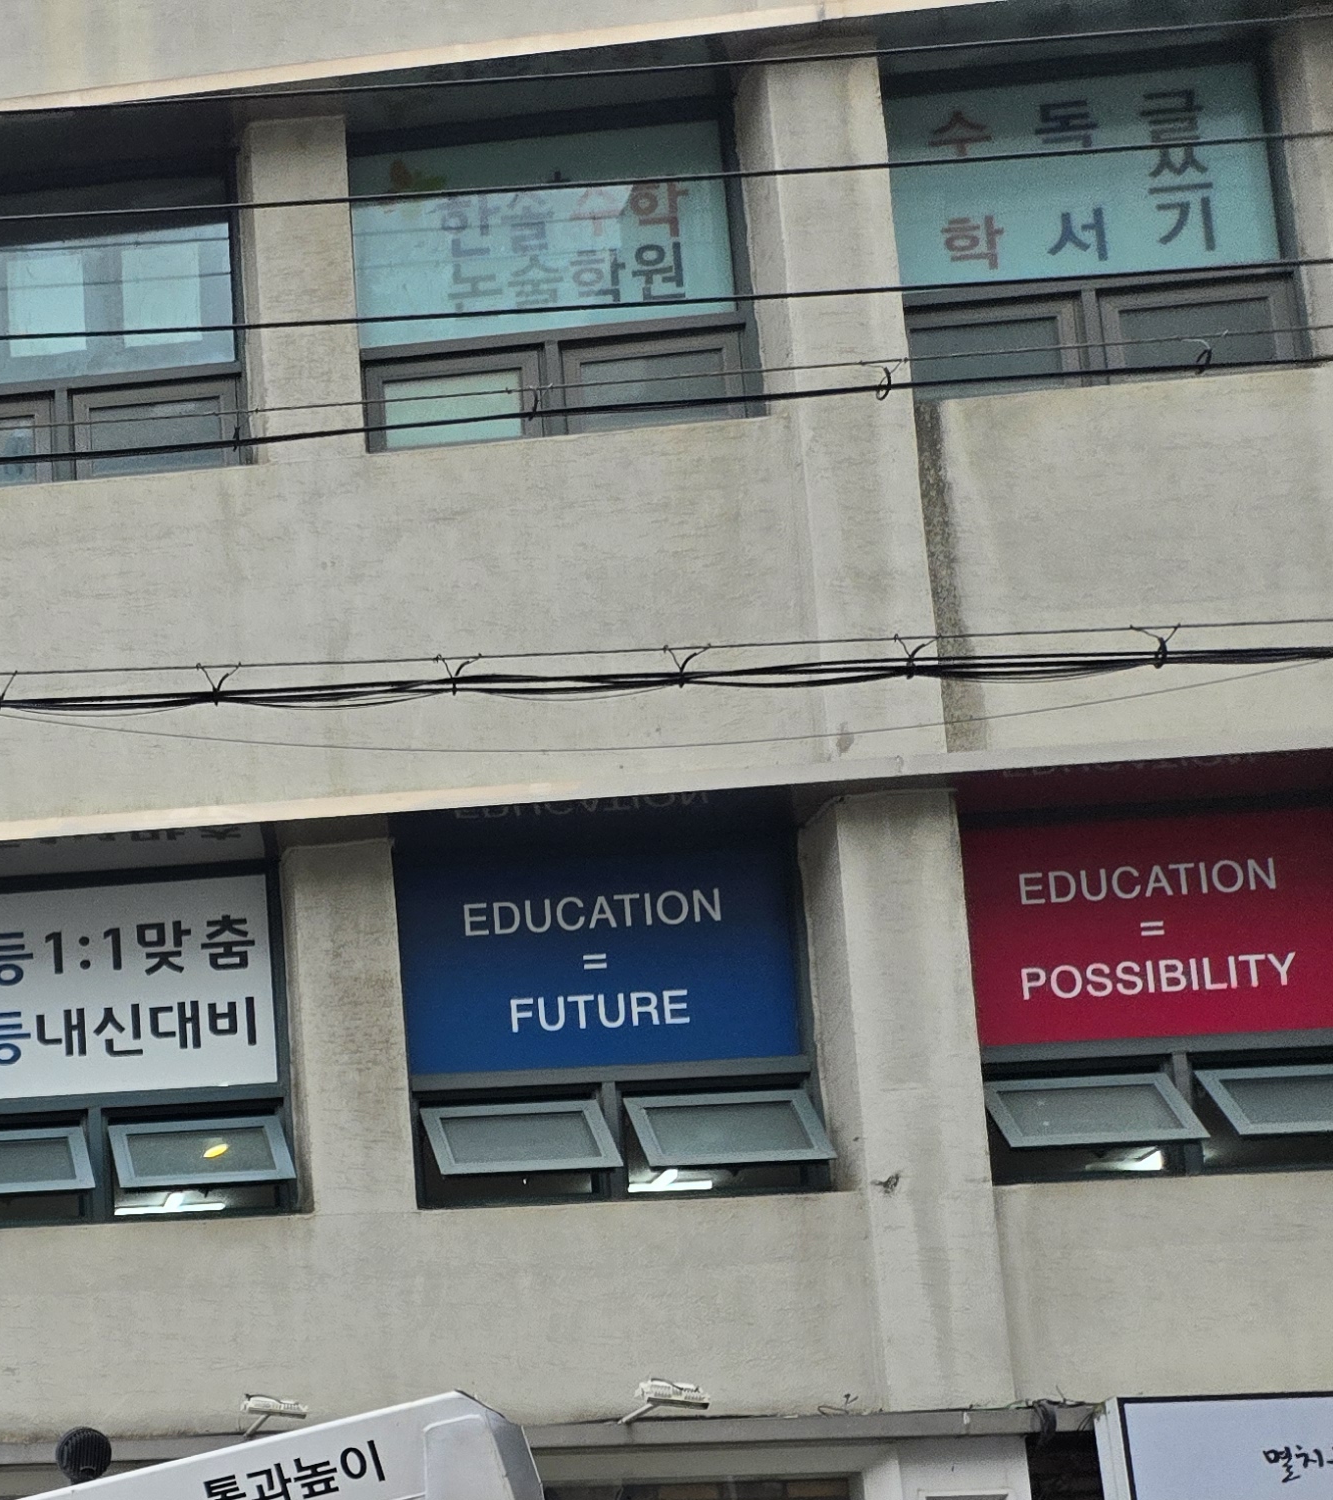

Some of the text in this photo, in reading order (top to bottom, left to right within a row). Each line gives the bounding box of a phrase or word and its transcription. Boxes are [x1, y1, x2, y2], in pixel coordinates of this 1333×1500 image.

[1019, 857, 1278, 906] EDUCATION
[463, 888, 721, 937] EDUCATION
[1021, 952, 1296, 1001] POSSIBILITY
[510, 990, 691, 1034] FUTURE
